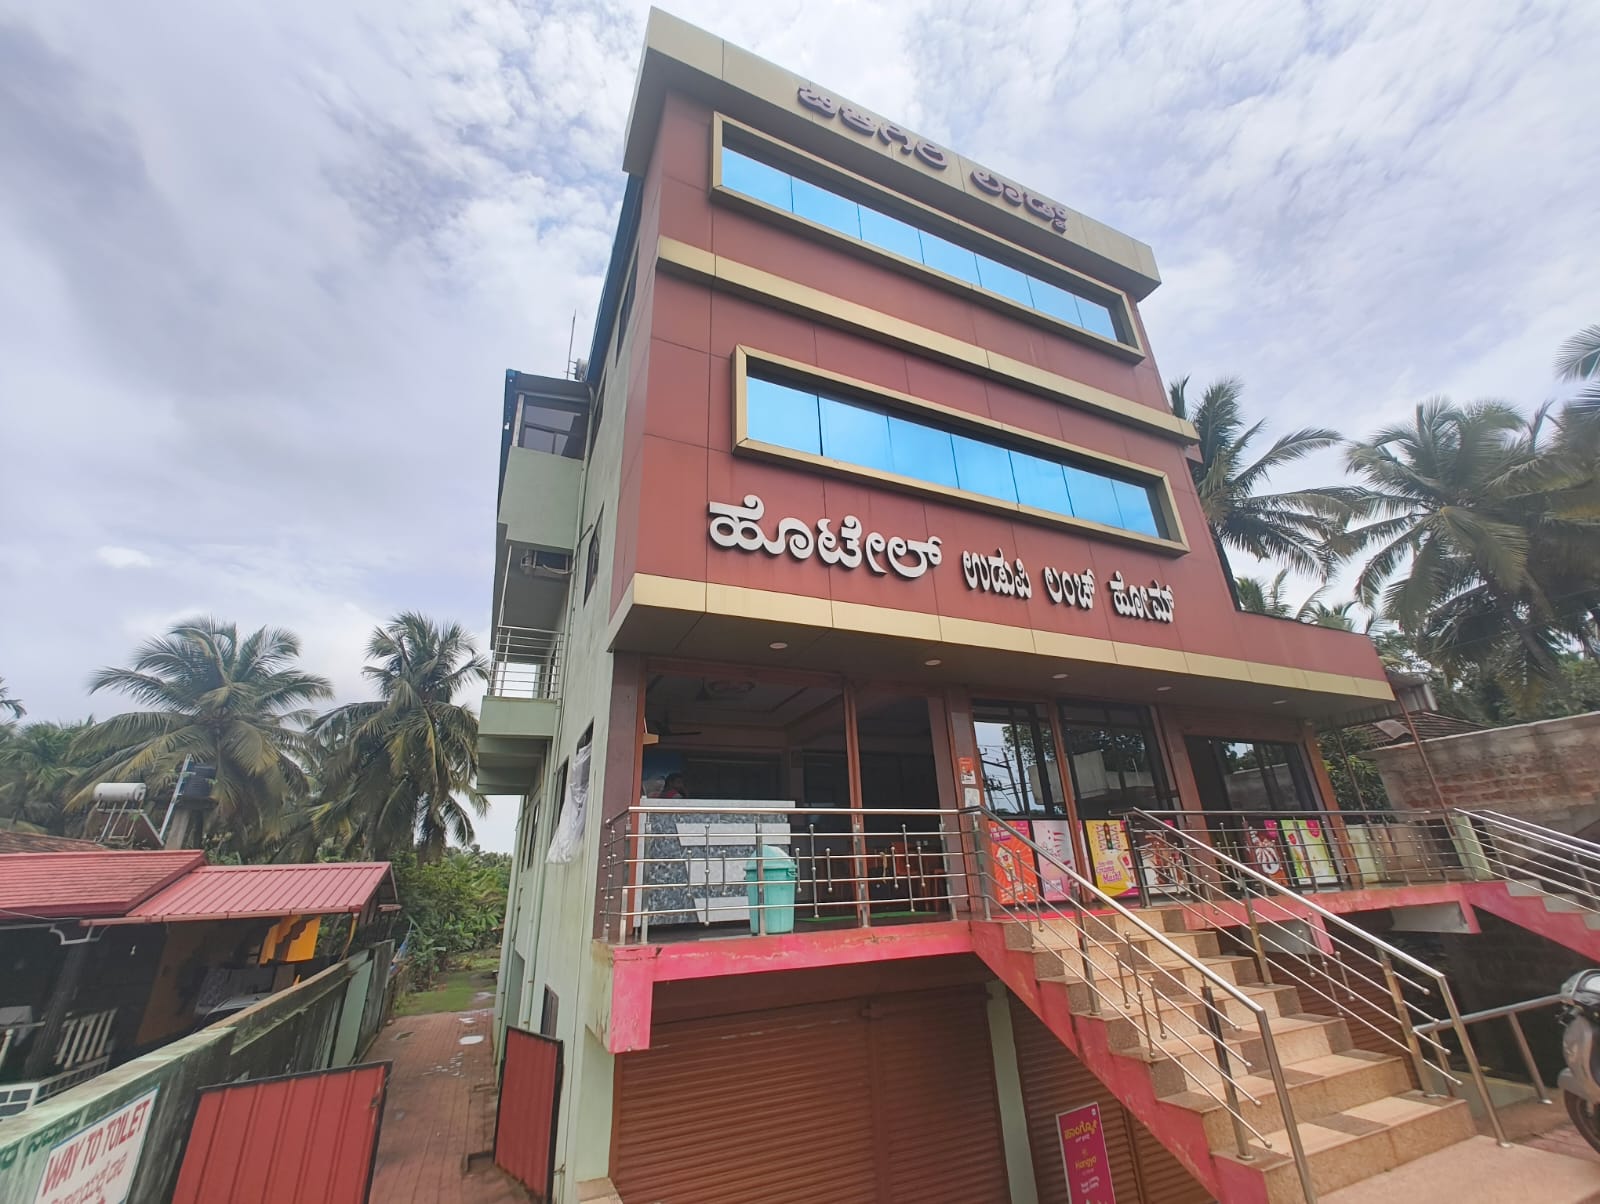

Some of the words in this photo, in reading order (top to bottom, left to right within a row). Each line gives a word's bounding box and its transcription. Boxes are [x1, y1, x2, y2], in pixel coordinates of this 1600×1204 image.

[708, 494, 943, 579] ಹೊಟೇಲ್
[962, 547, 1032, 599] ಉಡುಪಿ
[1044, 566, 1095, 609] ಲಂಚ್
[1109, 570, 1175, 623] ಹೋಮ್
[41, 1136, 86, 1197] WAY
[81, 1127, 103, 1170] TO
[101, 1099, 151, 1157] TOILET
